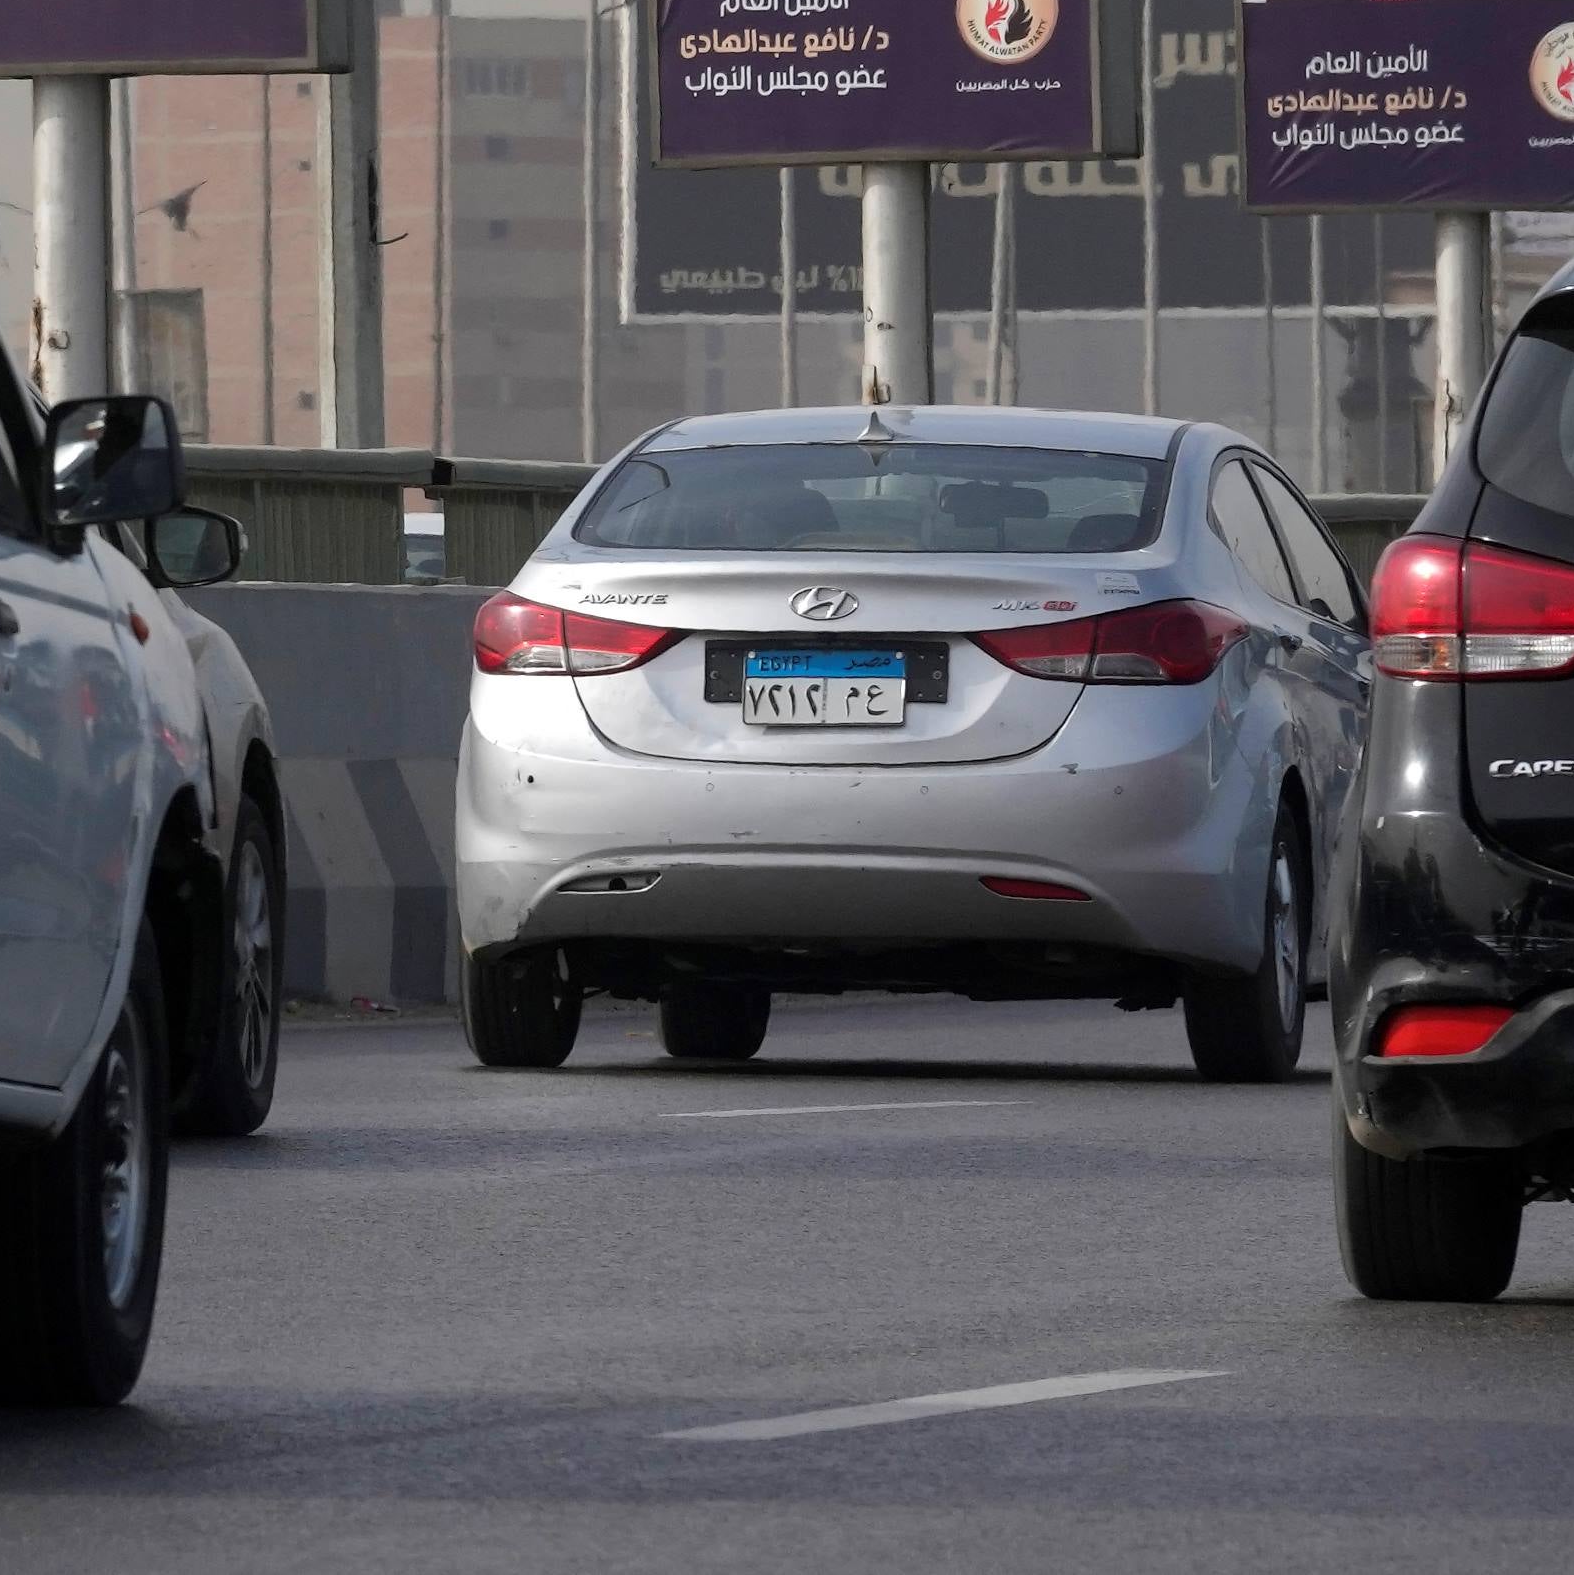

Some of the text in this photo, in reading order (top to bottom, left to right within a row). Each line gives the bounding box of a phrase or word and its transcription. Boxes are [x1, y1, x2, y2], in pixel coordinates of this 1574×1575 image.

[804, 27, 854, 57] نافع
[1306, 52, 1360, 79] العام
[686, 65, 887, 96] عضو مجلس النواب
[1272, 121, 1464, 150] عضو مجلس النواب
[578, 593, 669, 605] AVANTE
[759, 655, 813, 671] EGYPT
[843, 657, 891, 671] مصر
[748, 684, 821, 717] ٧٢١٢
